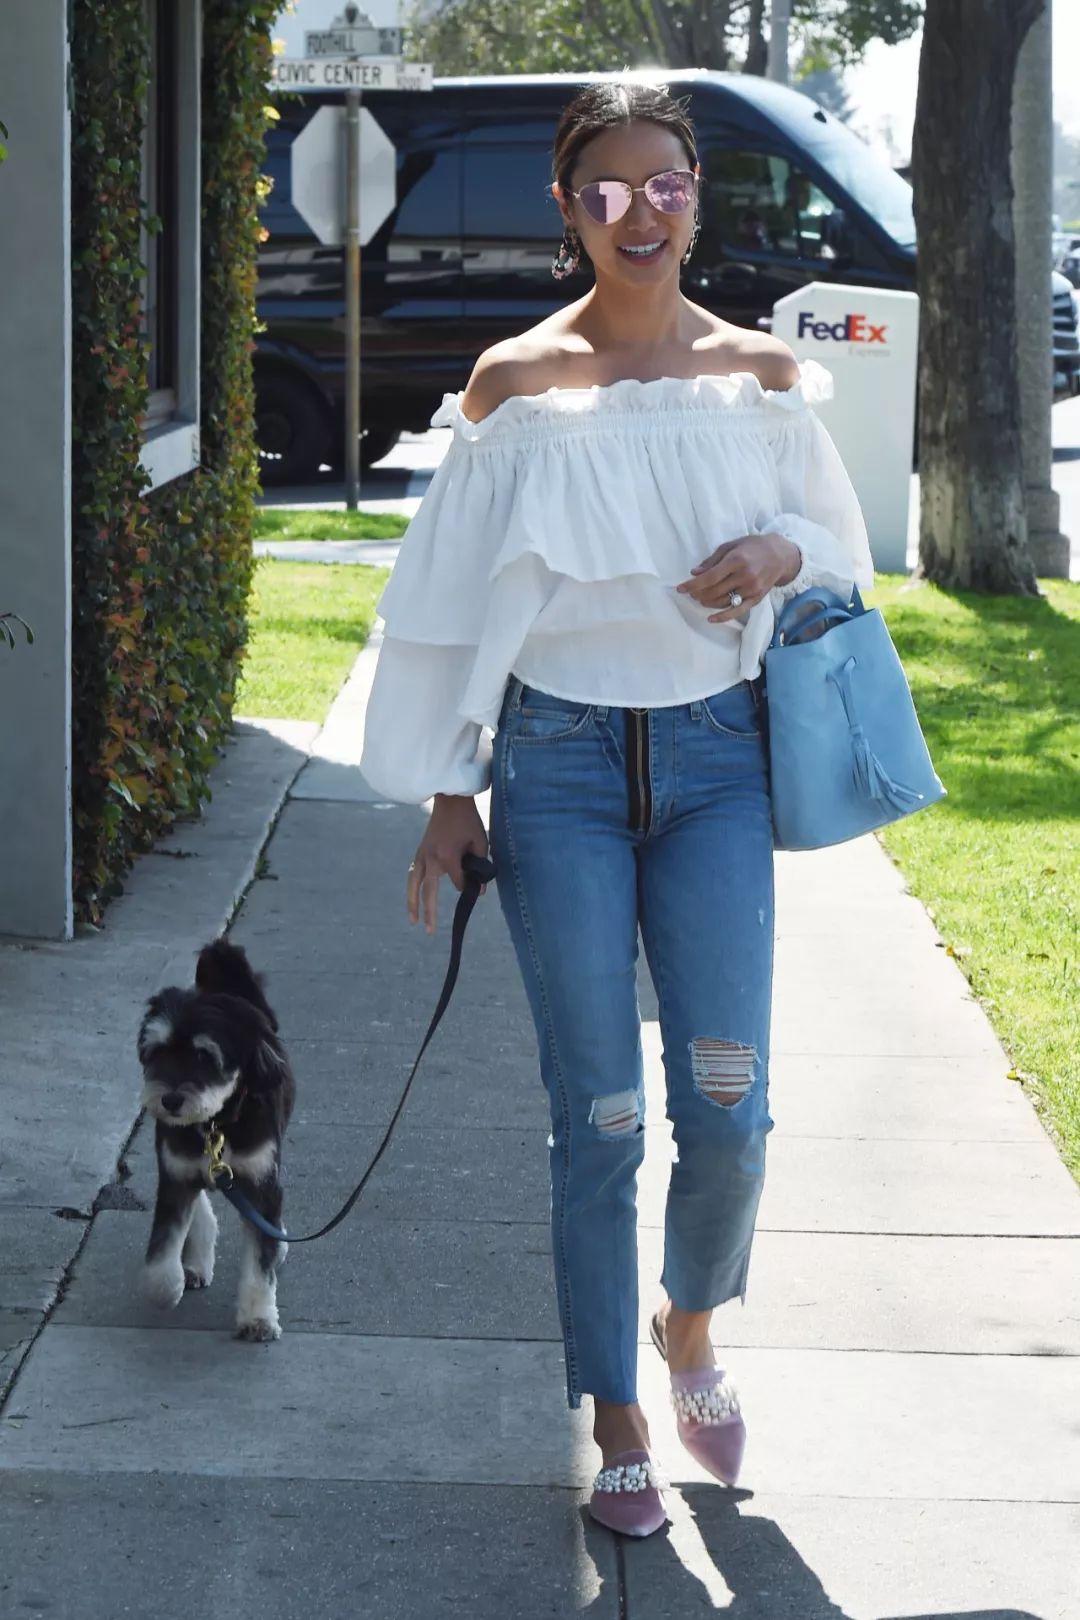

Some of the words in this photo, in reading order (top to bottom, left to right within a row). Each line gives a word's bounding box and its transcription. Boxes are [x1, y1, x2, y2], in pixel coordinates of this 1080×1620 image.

[278, 64, 315, 83] CIVIC
[323, 65, 382, 85] CENTER
[797, 312, 887, 343] FedEx
